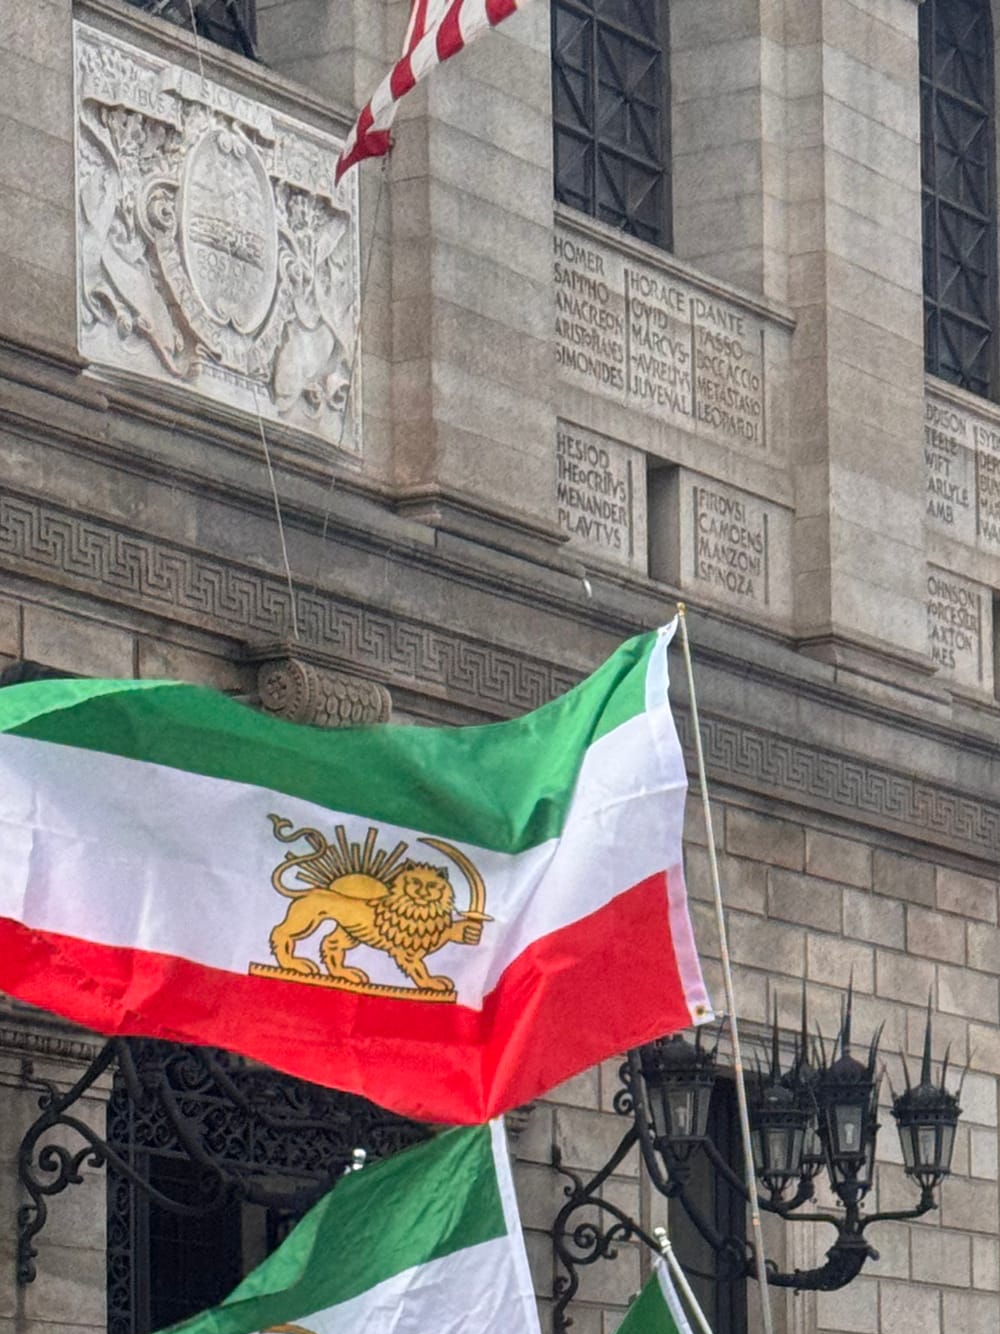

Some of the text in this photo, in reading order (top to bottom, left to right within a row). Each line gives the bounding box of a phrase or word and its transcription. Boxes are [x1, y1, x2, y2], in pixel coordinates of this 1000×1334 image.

[553, 236, 605, 276] HOMER
[553, 262, 610, 304] SAPPHO
[630, 271, 685, 311] HORACE
[556, 288, 624, 335] ANACREON
[631, 297, 668, 330] OVID
[695, 298, 745, 336] DANTE
[697, 325, 744, 360] TASSO
[553, 342, 624, 390] SIMONIDES
[696, 349, 760, 391] BOCCACCIO
[697, 401, 759, 442] LEOPARDI
[926, 403, 967, 435] DDISON
[556, 431, 610, 470] HESIOD
[924, 425, 958, 456] TEELE
[924, 450, 950, 477] WIFT
[557, 482, 628, 527] MENANDER
[928, 477, 970, 508] ARLYLE
[927, 500, 953, 524] AMB
[700, 513, 763, 554] CAMOENS
[700, 536, 761, 577] MANZONI
[700, 561, 755, 599] SPINOZA
[927, 576, 975, 608] OHNSON
[930, 625, 973, 653] AXTON
